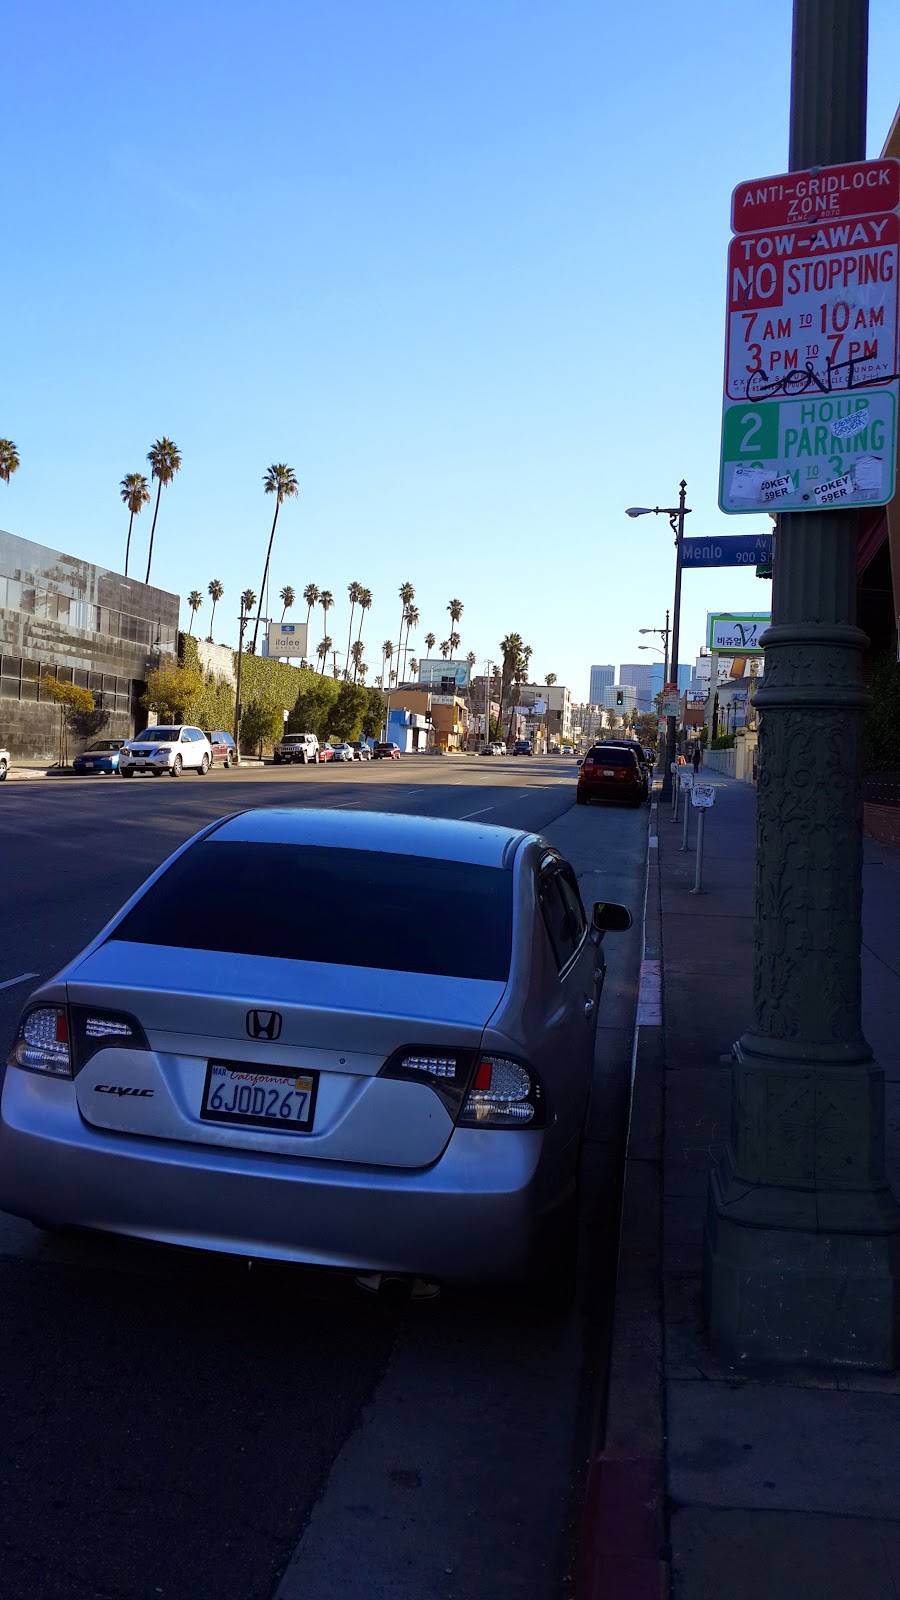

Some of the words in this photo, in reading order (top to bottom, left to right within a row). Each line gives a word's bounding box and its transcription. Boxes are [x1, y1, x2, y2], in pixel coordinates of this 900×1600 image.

[743, 168, 890, 207] ANTI-GRIDLOCK
[787, 194, 840, 216] ZONE
[741, 219, 888, 260] TOW-AWAY
[732, 262, 777, 302] NO
[787, 250, 893, 295] STOPPING
[741, 312, 758, 343] 7
[763, 318, 791, 340] AM
[799, 313, 813, 327] TO
[820, 302, 850, 334] 10
[854, 306, 884, 330] AM
[746, 343, 762, 374] 3
[769, 349, 798, 371] PM
[806, 344, 819, 358] TO
[826, 334, 845, 365] 7
[849, 338, 878, 362] PM
[739, 411, 763, 453] 2
[784, 419, 885, 458] PARKING
[806, 464, 819, 478] TO
[761, 476, 790, 490] COKEY
[814, 475, 849, 495] COKEY
[765, 487, 789, 500] 59ER
[821, 487, 848, 503] 59ER
[682, 543, 722, 560] Menlo
[755, 538, 767, 548] AV
[736, 551, 755, 563] 900
[760, 551, 767, 562] S
[213, 1067, 226, 1076] MAR
[230, 1071, 294, 1086] California
[94, 1084, 155, 1097] CIVIC
